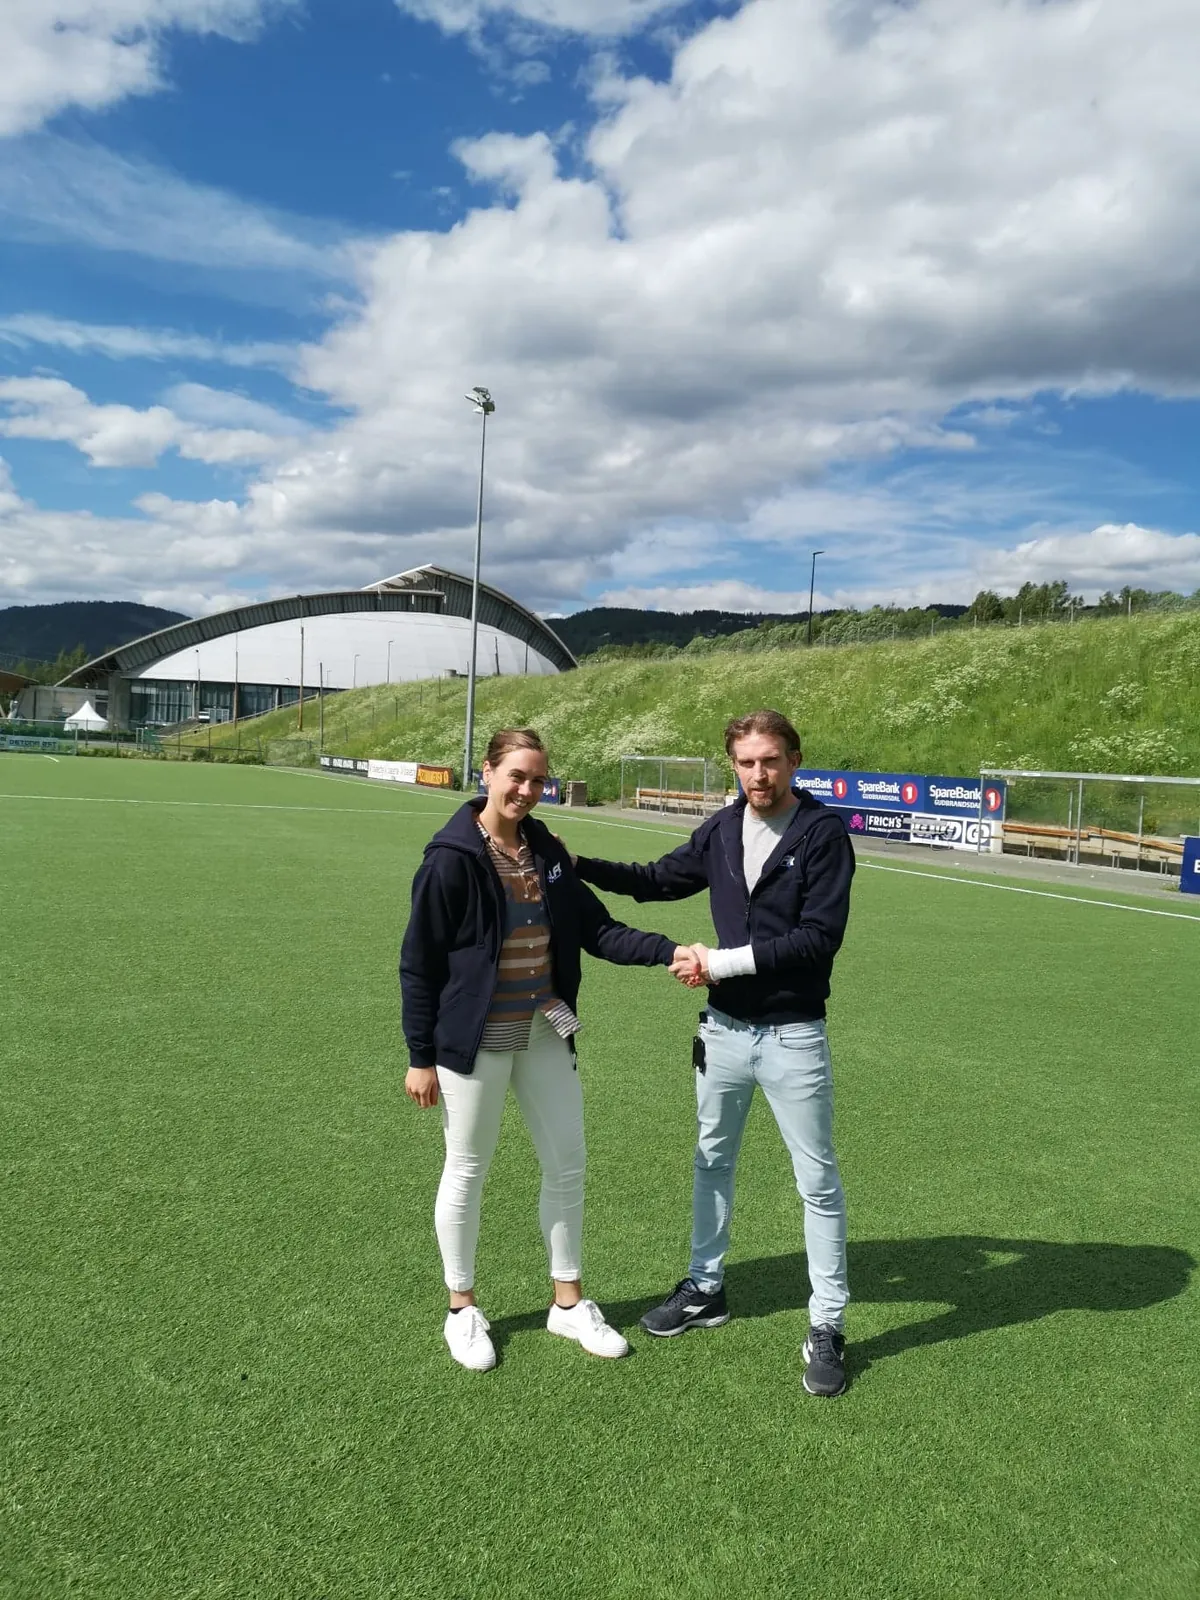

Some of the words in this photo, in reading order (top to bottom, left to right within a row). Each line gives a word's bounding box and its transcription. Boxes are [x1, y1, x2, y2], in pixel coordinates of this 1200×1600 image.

[795, 776, 833, 790] SpareBank
[837, 781, 843, 795] 1
[857, 780, 900, 794] SpareBank
[906, 786, 913, 800] 1
[929, 784, 982, 800] SpareBank
[988, 791, 996, 806] 1
[862, 793, 900, 802] GUDBRANDSDAL
[868, 815, 902, 829] FRICH'S
